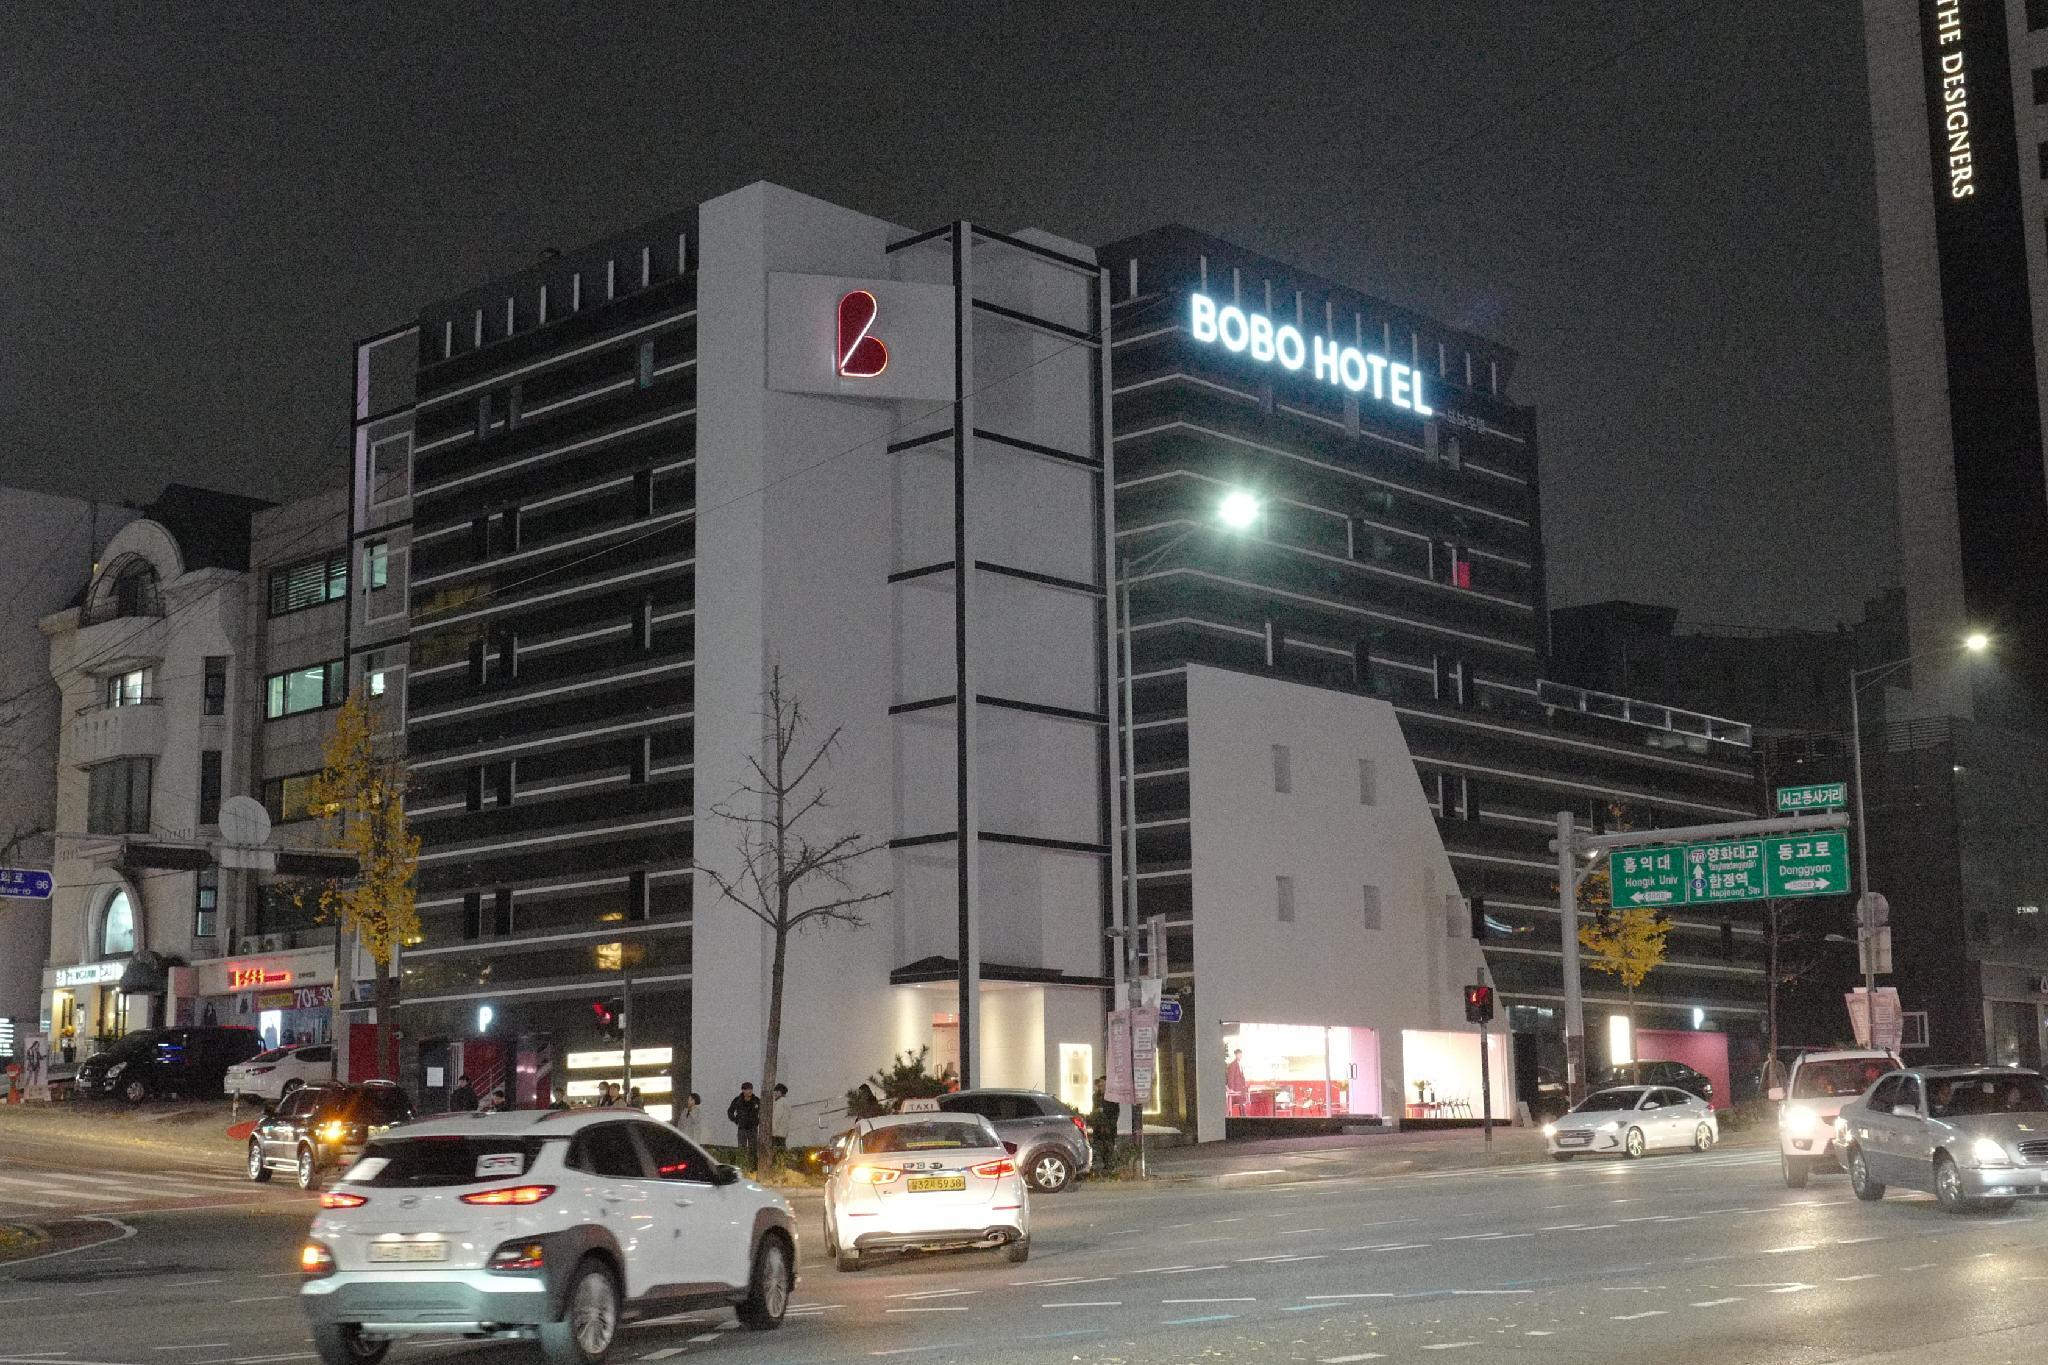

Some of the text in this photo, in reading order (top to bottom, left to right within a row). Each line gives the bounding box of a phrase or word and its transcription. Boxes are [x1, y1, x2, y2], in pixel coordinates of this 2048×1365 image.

[1942, 51, 1975, 198] DESIGNERS
[1191, 292, 1433, 416] BOBO HOTEL
[1781, 787, 1842, 806] 서교동사거리
[1707, 845, 1759, 862] 양화대교
[1778, 841, 1831, 861] 동교로
[1624, 853, 1670, 873] 홍익대
[1780, 864, 1831, 876] Donggyoro
[36, 880, 49, 890] 96
[1625, 874, 1678, 889] Hongik Univ
[1709, 871, 1749, 889] 합정역
[479, 1006, 493, 1032] P
[910, 1103, 935, 1111] TAXI
